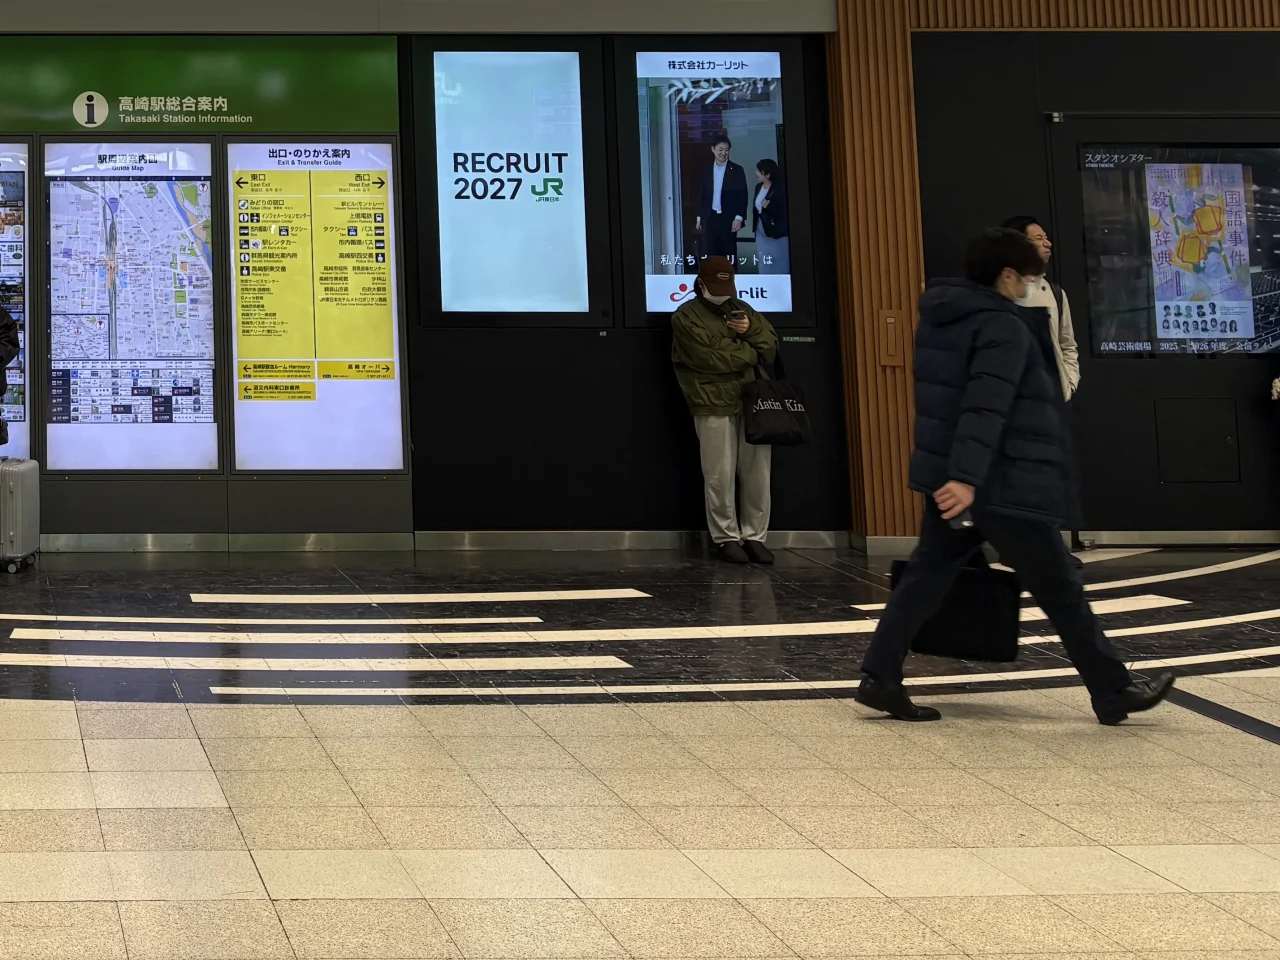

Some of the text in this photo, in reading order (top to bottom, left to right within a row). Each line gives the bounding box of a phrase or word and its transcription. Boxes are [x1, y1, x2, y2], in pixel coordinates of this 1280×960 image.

[668, 60, 749, 70] 株式会社カーリット
[119, 96, 228, 112] 高崎駅総合案内
[119, 114, 253, 123] Takasaki Station Information
[269, 148, 350, 159] 出口・のりかえ案内
[1085, 154, 1153, 163] スタジオシアター
[453, 152, 568, 173] RECRUIT
[454, 178, 564, 200] 2027 JR
[660, 254, 773, 265] 私たちリットは
[1100, 342, 1152, 351] 高崎芸術劇場
